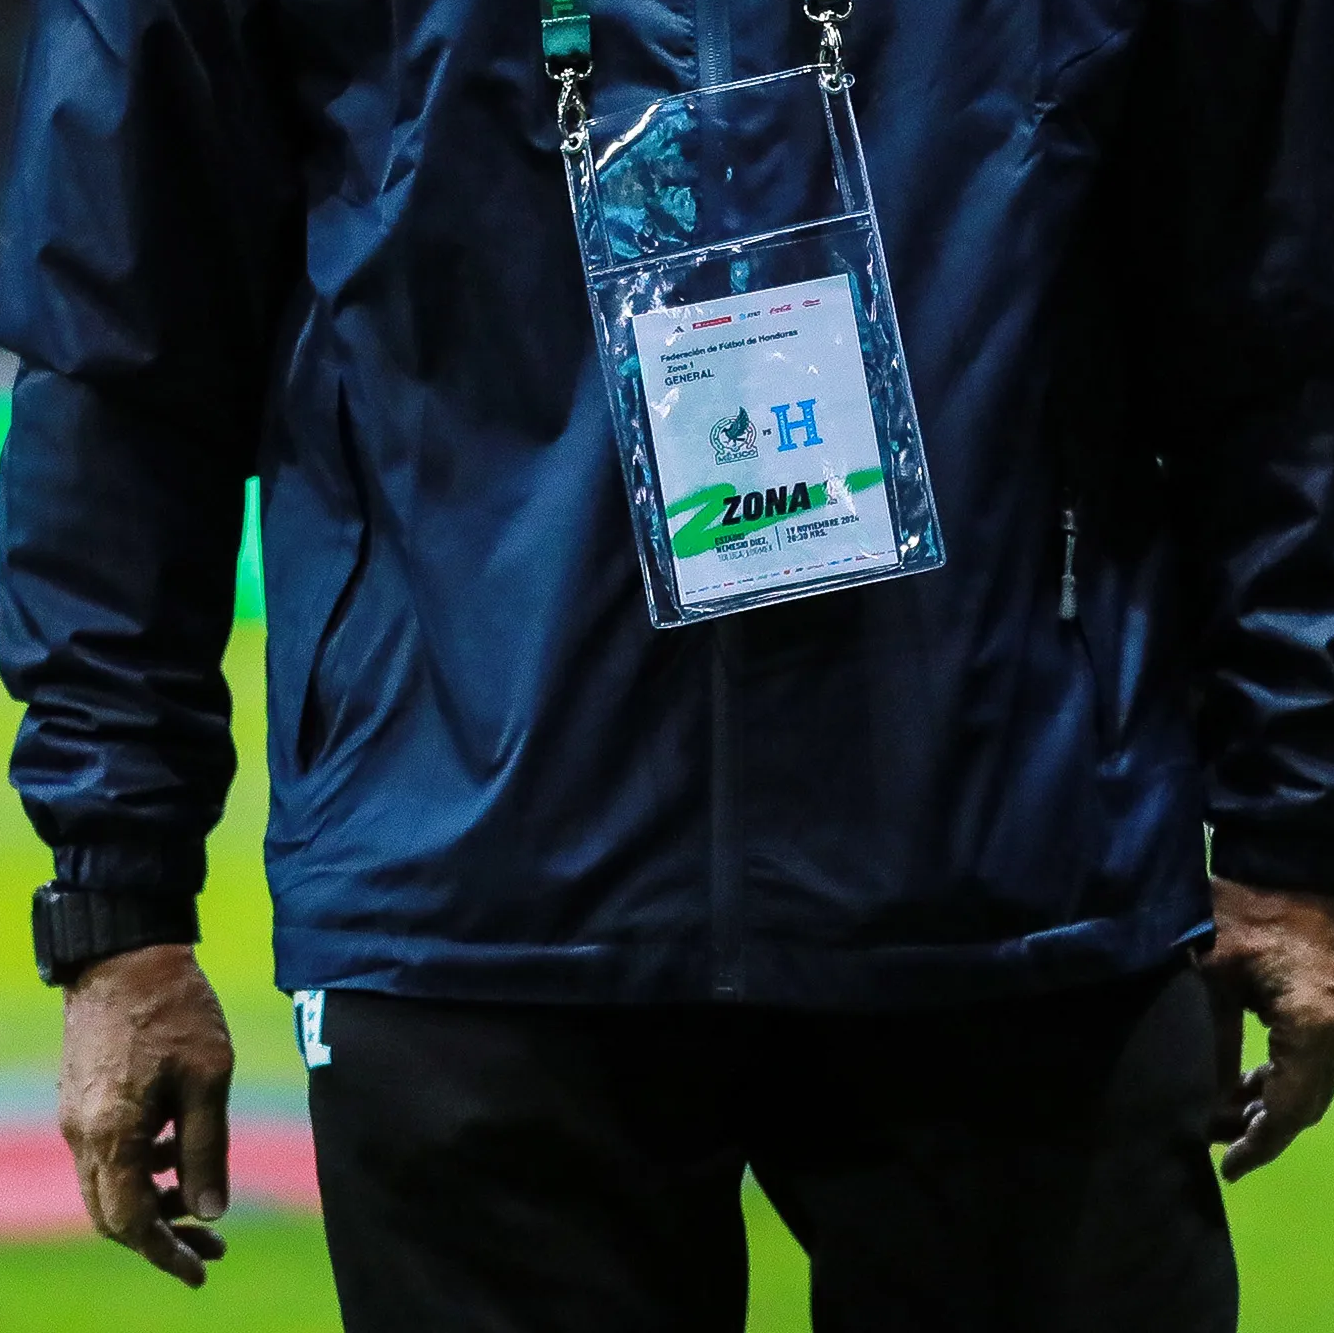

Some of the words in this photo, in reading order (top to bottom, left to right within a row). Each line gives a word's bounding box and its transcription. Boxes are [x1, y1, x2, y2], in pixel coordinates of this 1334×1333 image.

[660, 347, 706, 363] Federación
[706, 345, 718, 354] de
[719, 338, 746, 351] Fútbol
[746, 336, 758, 346] de
[759, 328, 799, 344] Honduras
[664, 368, 715, 386] GENERAL
[667, 363, 688, 374] Zona
[770, 398, 824, 453] H
[721, 481, 812, 527] ZONA
[797, 517, 839, 534] NOVIEMBRE
